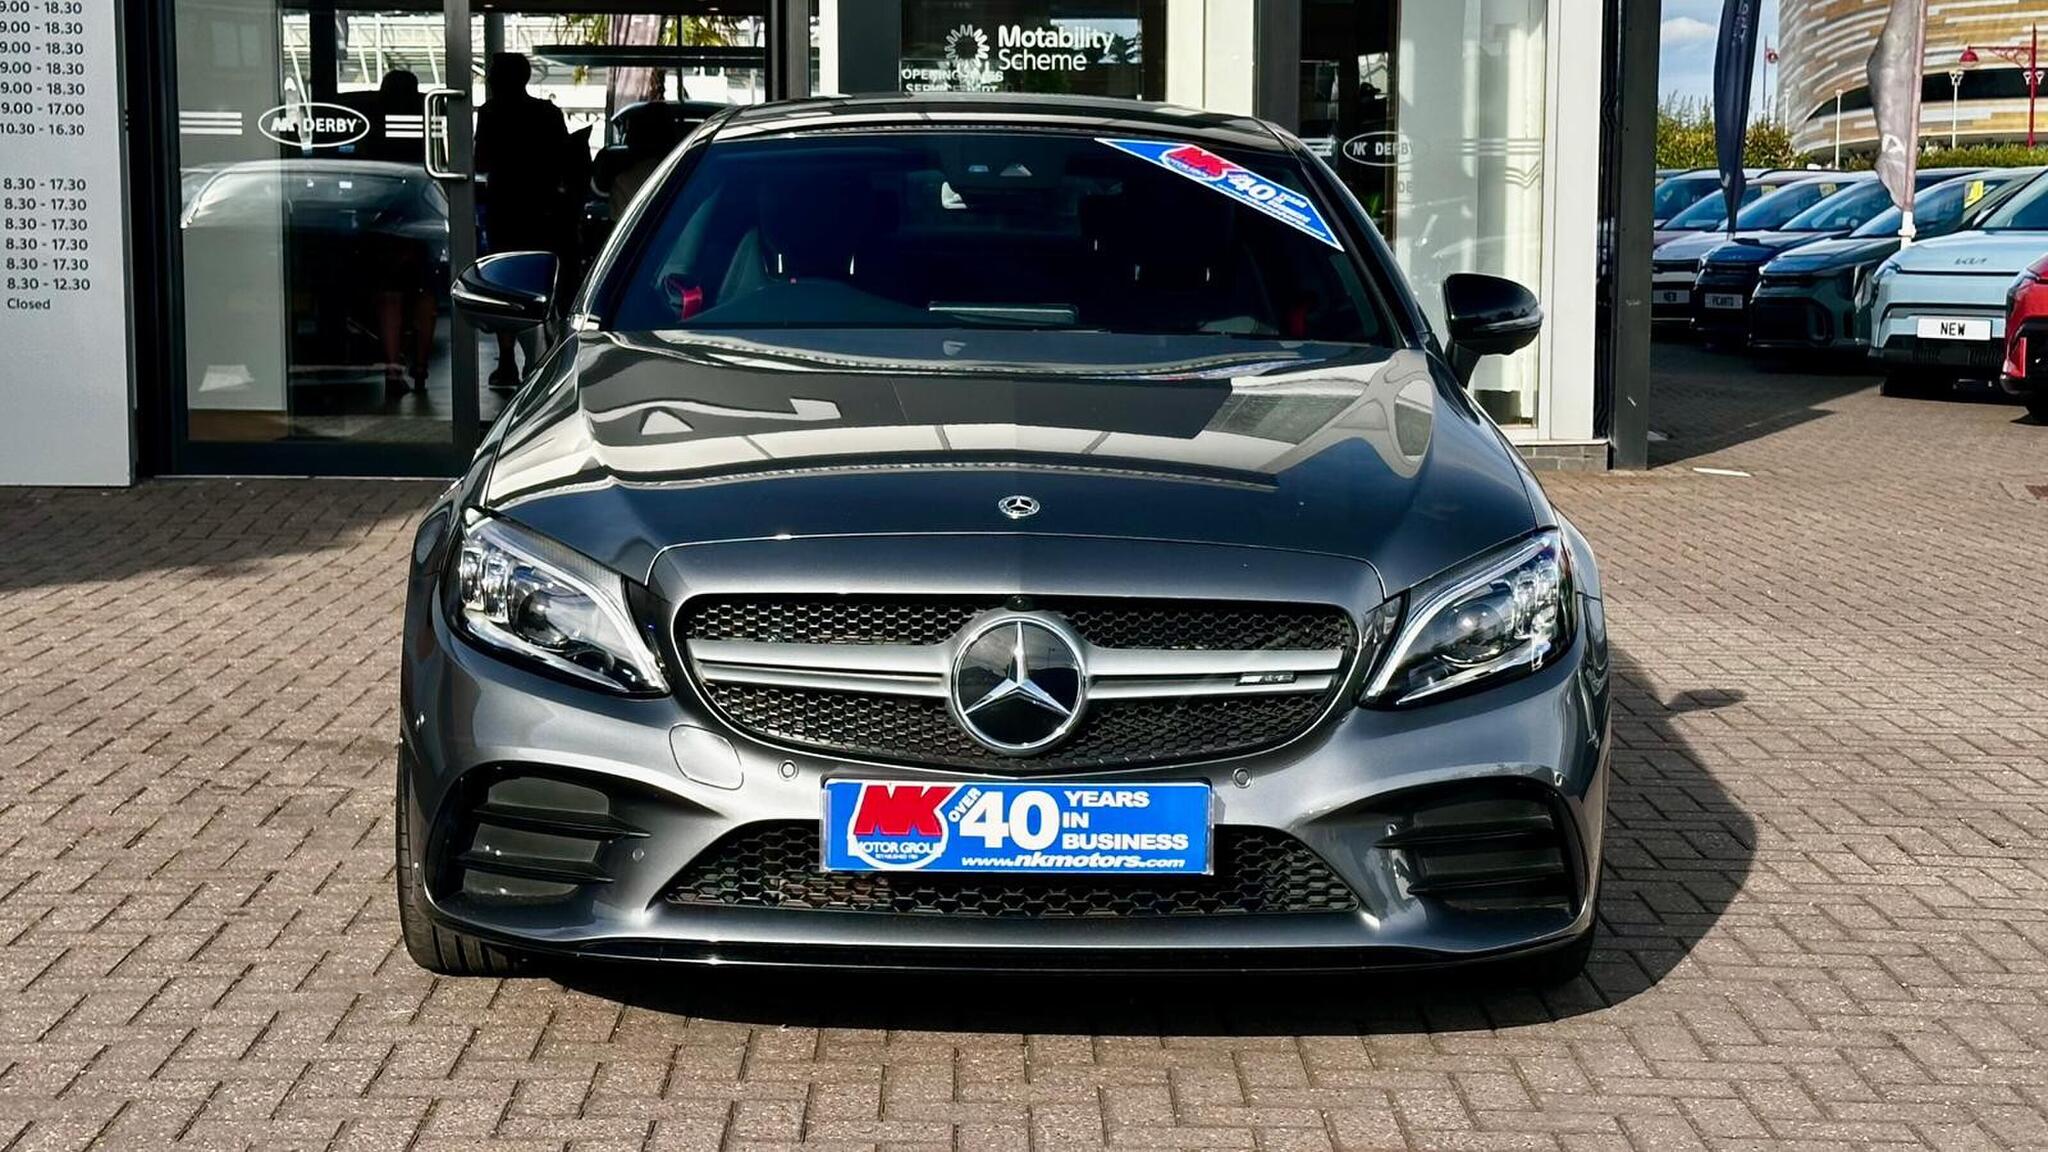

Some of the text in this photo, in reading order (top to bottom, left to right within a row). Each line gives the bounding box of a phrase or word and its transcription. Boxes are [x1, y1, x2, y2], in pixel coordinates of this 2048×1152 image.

[0, 1, 29, 13] 9.00
[45, 2, 82, 14] 18.30
[0, 21, 30, 33] 9.00
[45, 22, 83, 34] 18.30
[998, 24, 1115, 54] Motability
[0, 41, 31, 53] 9.00
[46, 42, 83, 55] 18.30
[998, 48, 1088, 71] Scheme
[0, 62, 31, 74] 9.00
[47, 63, 84, 75] 18.30
[1, 82, 32, 94] 9.00
[47, 83, 85, 95] 18.30
[1, 102, 33, 114] 9.00
[48, 103, 84, 115] 17.00
[0, 123, 34, 134] 10.30
[49, 124, 84, 135] 16.30
[303, 118, 357, 133] DERBY
[1353, 142, 1367, 155] NK
[1166, 147, 1233, 178] NK
[4, 178, 35, 190] 8.30
[50, 179, 86, 190] 17.30
[1227, 174, 1277, 201] 40
[5, 198, 36, 210] 8.30
[51, 199, 86, 210] 17.30
[5, 218, 36, 230] 8.30
[52, 219, 87, 230] 17.30
[6, 238, 37, 250] 8.30
[53, 239, 88, 250] 17.30
[6, 258, 38, 270] 8.30
[53, 259, 88, 270] 17.30
[7, 277, 38, 290] 8.30
[53, 278, 90, 290] 12.30
[7, 298, 50, 309] Closed
[1940, 322, 1966, 337] NEW
[1064, 790, 1150, 808] YEARS
[853, 785, 956, 836] NK
[948, 788, 1060, 850] OVER 40
[1062, 812, 1089, 829] IN
[1062, 833, 1189, 850] BUSINESS
[961, 851, 1185, 868] www.nkmotors.com
